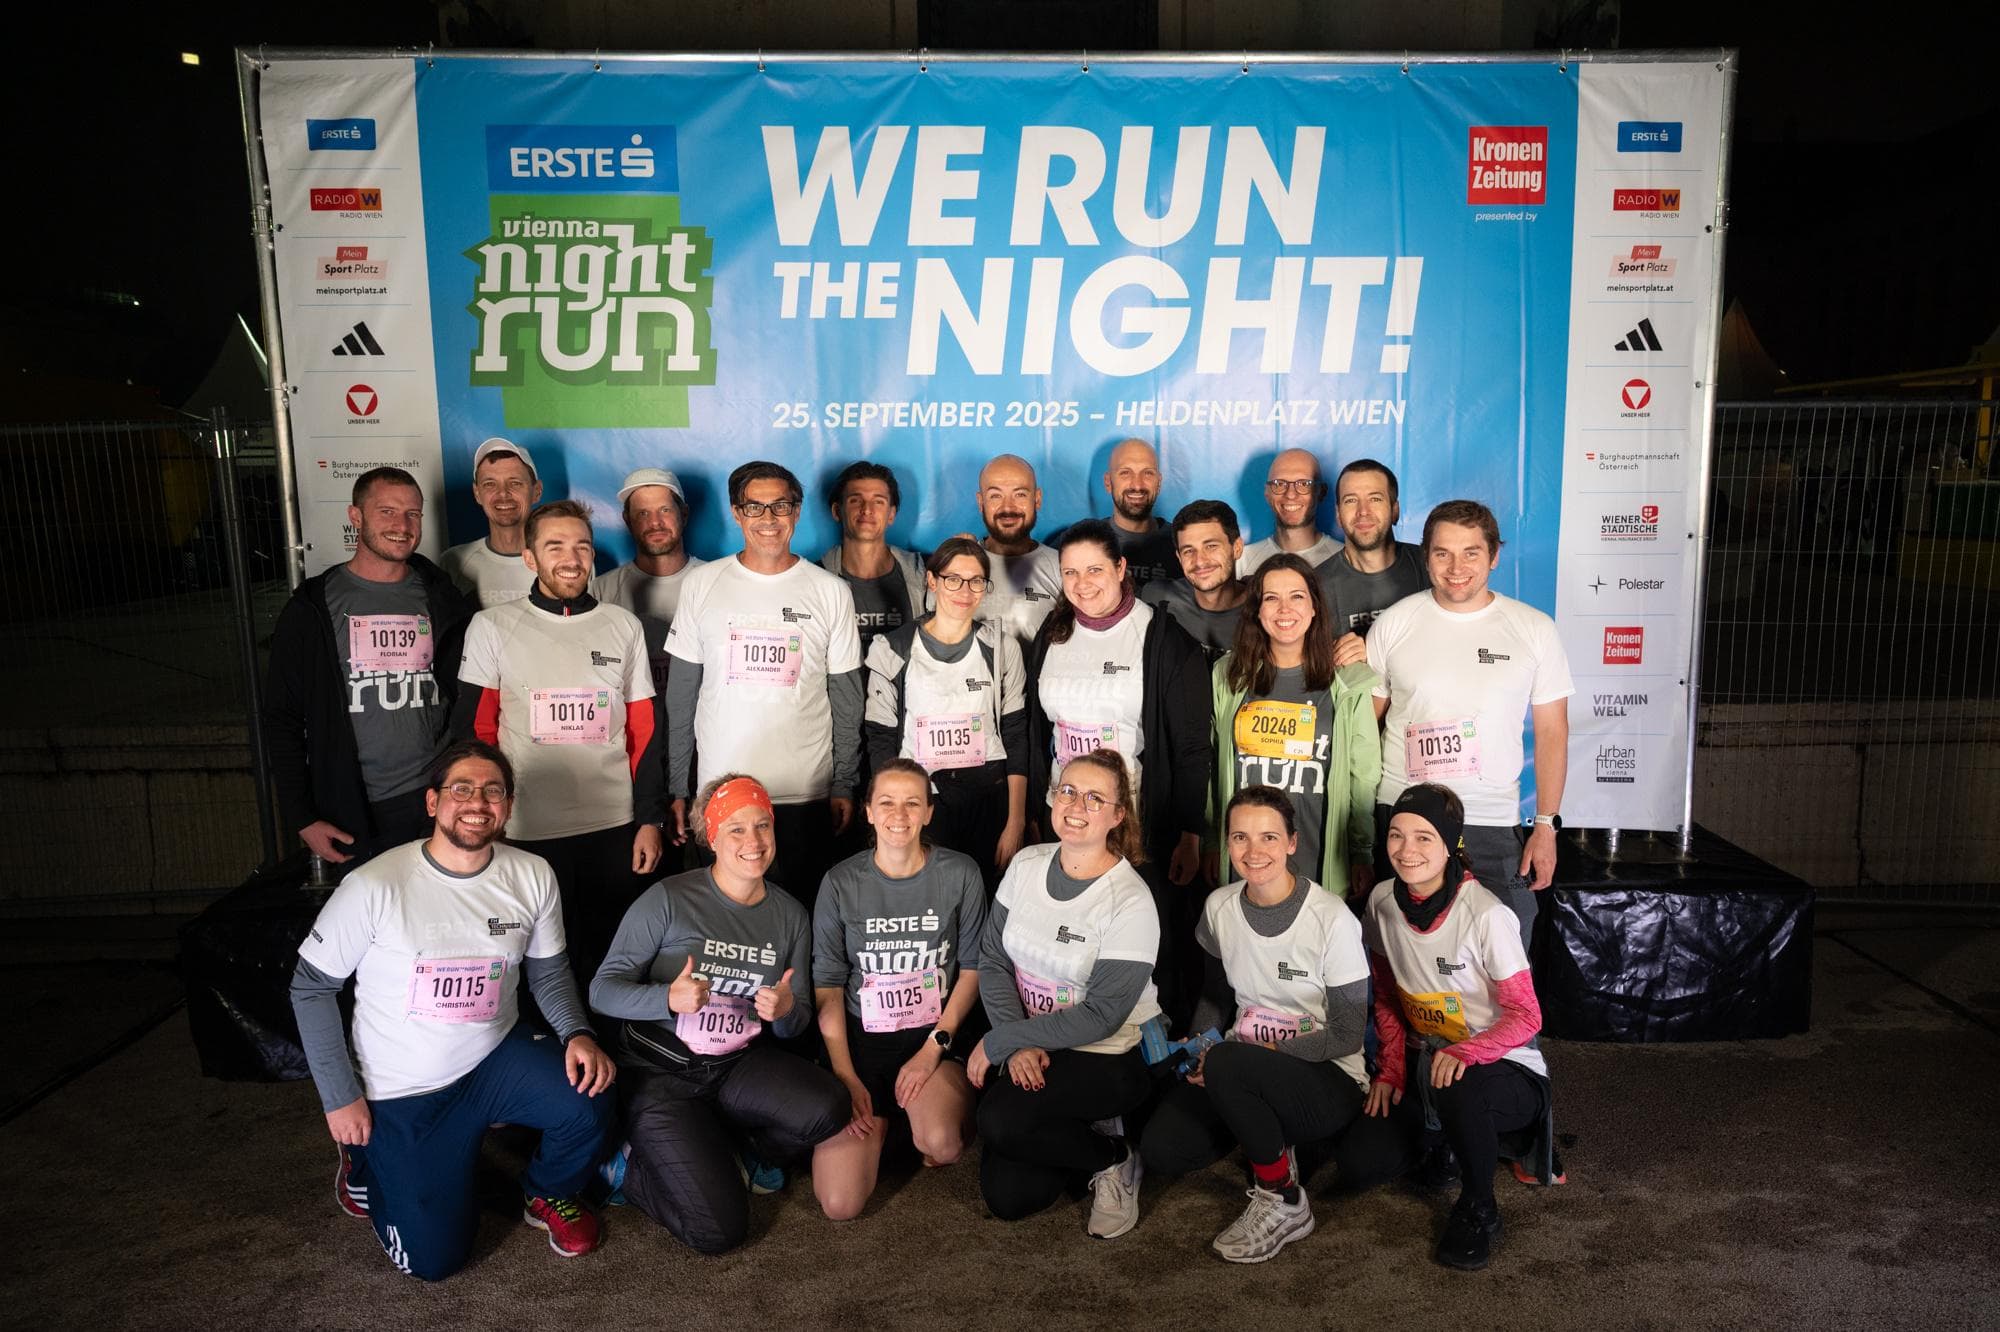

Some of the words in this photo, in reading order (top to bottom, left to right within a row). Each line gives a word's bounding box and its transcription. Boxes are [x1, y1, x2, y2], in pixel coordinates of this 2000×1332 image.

[321, 130, 350, 139] ERSTE
[1631, 132, 1659, 141] ERSTE
[1473, 137, 1543, 161] Kronen
[510, 146, 615, 178] ERSTE
[1472, 165, 1543, 192] Zeitung
[761, 124, 987, 247] WE
[1009, 125, 1327, 249] RUN
[314, 194, 356, 205] RADIO
[1617, 194, 1657, 205] RADIO
[1475, 211, 1523, 222] presented
[1525, 212, 1538, 222] by
[501, 214, 600, 239] vienna
[343, 249, 362, 258] Mein
[1637, 248, 1656, 256] Mein
[324, 264, 352, 276] Sport
[354, 264, 379, 274] Platz
[476, 224, 697, 311] night
[1617, 262, 1645, 274] Sport
[1646, 262, 1669, 273] Platz
[316, 287, 387, 296] meinsportplatz.at
[1606, 284, 1674, 294] meinsportplatz.at
[773, 261, 901, 319] THE
[906, 255, 1424, 378] NIGHT!
[474, 296, 701, 372] run
[772, 402, 818, 429] 25.
[823, 401, 996, 428] SEPTEMBER
[1004, 400, 1080, 428] 2025
[1115, 399, 1320, 426] HELDENPLATZ
[1330, 398, 1407, 425] WIEN
[1599, 452, 1680, 462] Burghauptmannschaft
[1598, 462, 1639, 471] Österreich
[1601, 515, 1641, 524] WIENER
[1600, 524, 1658, 534] STÄDTISCHE
[1618, 578, 1665, 590] Polestar
[370, 629, 416, 648] 10139
[1606, 632, 1641, 644] Kronen
[743, 644, 786, 664] 10130
[1605, 645, 1640, 659] Zeitung
[348, 672, 440, 713] run
[1592, 694, 1648, 705] VITAMIN
[549, 702, 595, 722] 10116
[1592, 705, 1627, 717] WELL
[1251, 715, 1297, 737] 20248
[928, 728, 970, 748] 10135
[1260, 737, 1284, 745] SOPHIA
[1417, 734, 1462, 758] 10133
[1599, 744, 1636, 758] urban
[934, 750, 966, 758] CHRISTINA
[1424, 757, 1458, 767] CHRISTIAN
[1238, 756, 1324, 794] run
[865, 916, 919, 935] ERSTE
[865, 938, 912, 951] vienna
[703, 939, 759, 964] ERSTE
[699, 961, 749, 980] vienna
[432, 976, 486, 998] 10115
[877, 986, 922, 1009] 10125
[435, 1001, 475, 1009] CHRISTIAN
[889, 1009, 914, 1018] KERSTIN
[698, 1011, 745, 1035] 10136
